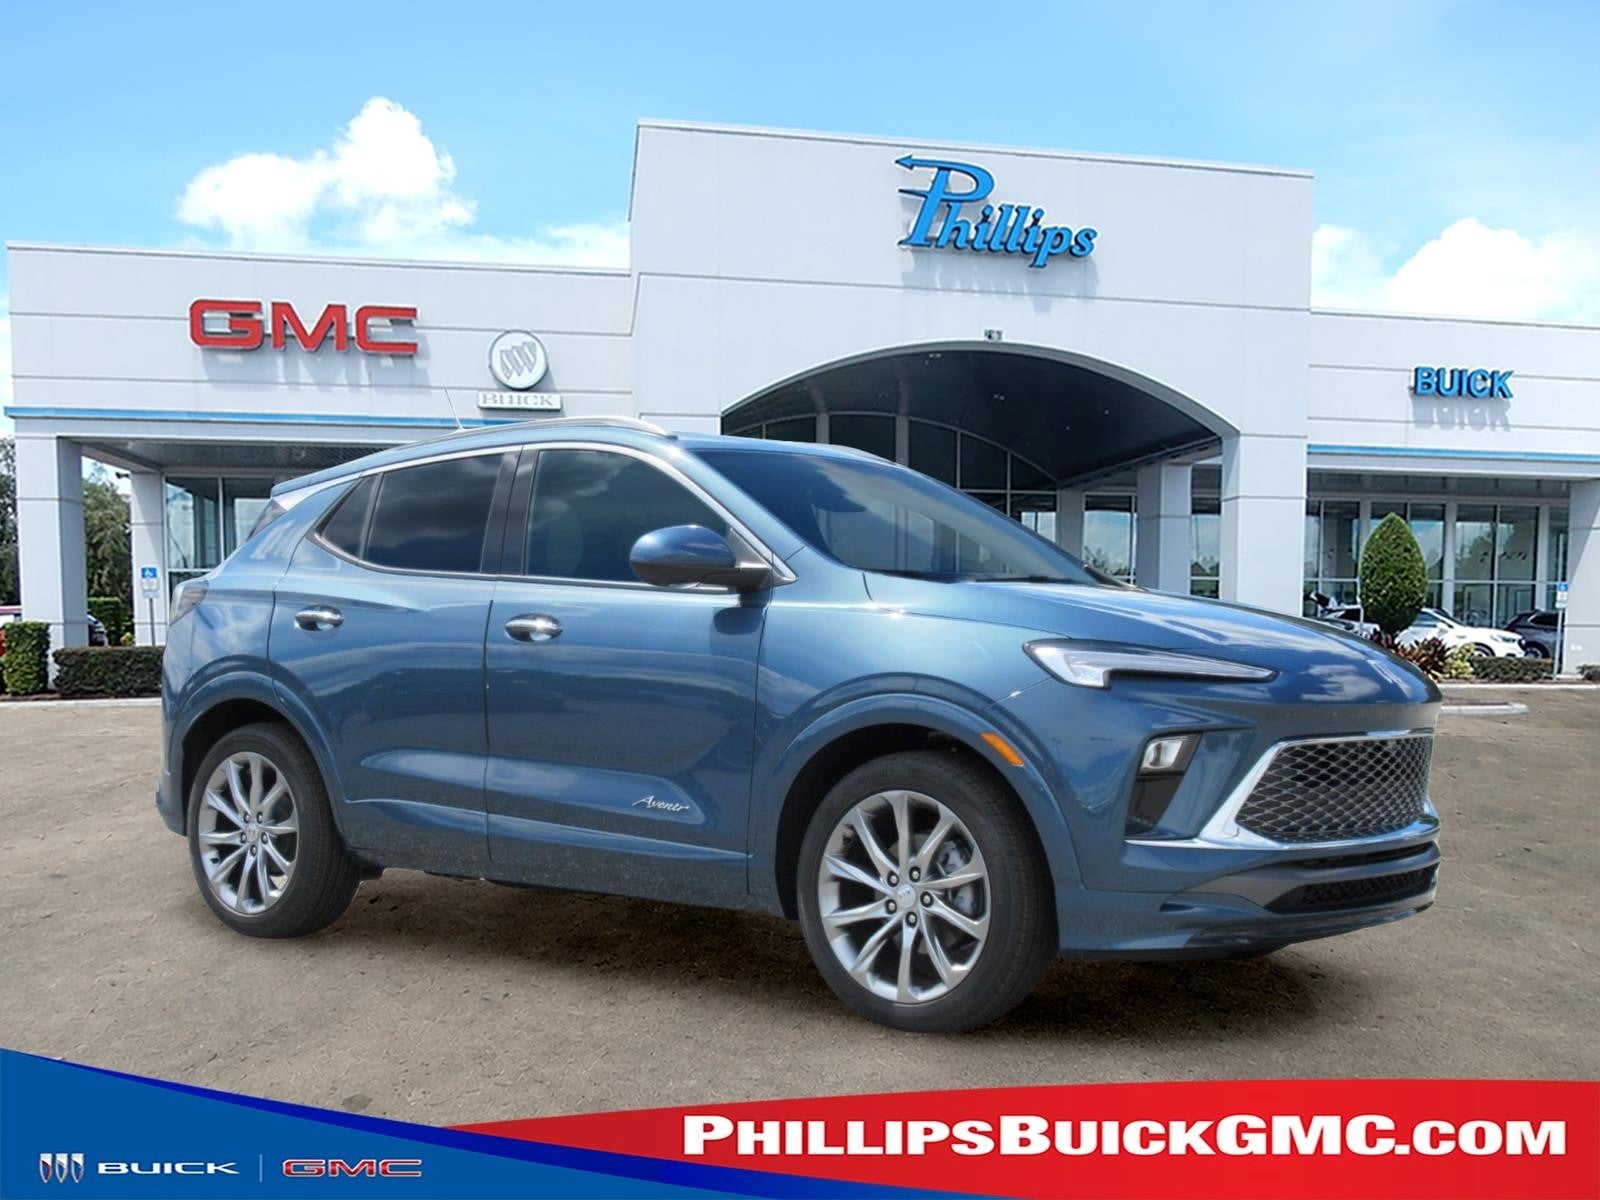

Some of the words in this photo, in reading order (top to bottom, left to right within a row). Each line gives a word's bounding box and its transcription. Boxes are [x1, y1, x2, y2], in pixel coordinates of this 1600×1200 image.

[895, 154, 1098, 269] Phillips
[189, 299, 418, 356] GMC
[482, 393, 554, 406] BUICK
[1414, 366, 1514, 400] BUICK
[632, 795, 690, 812] Avenir
